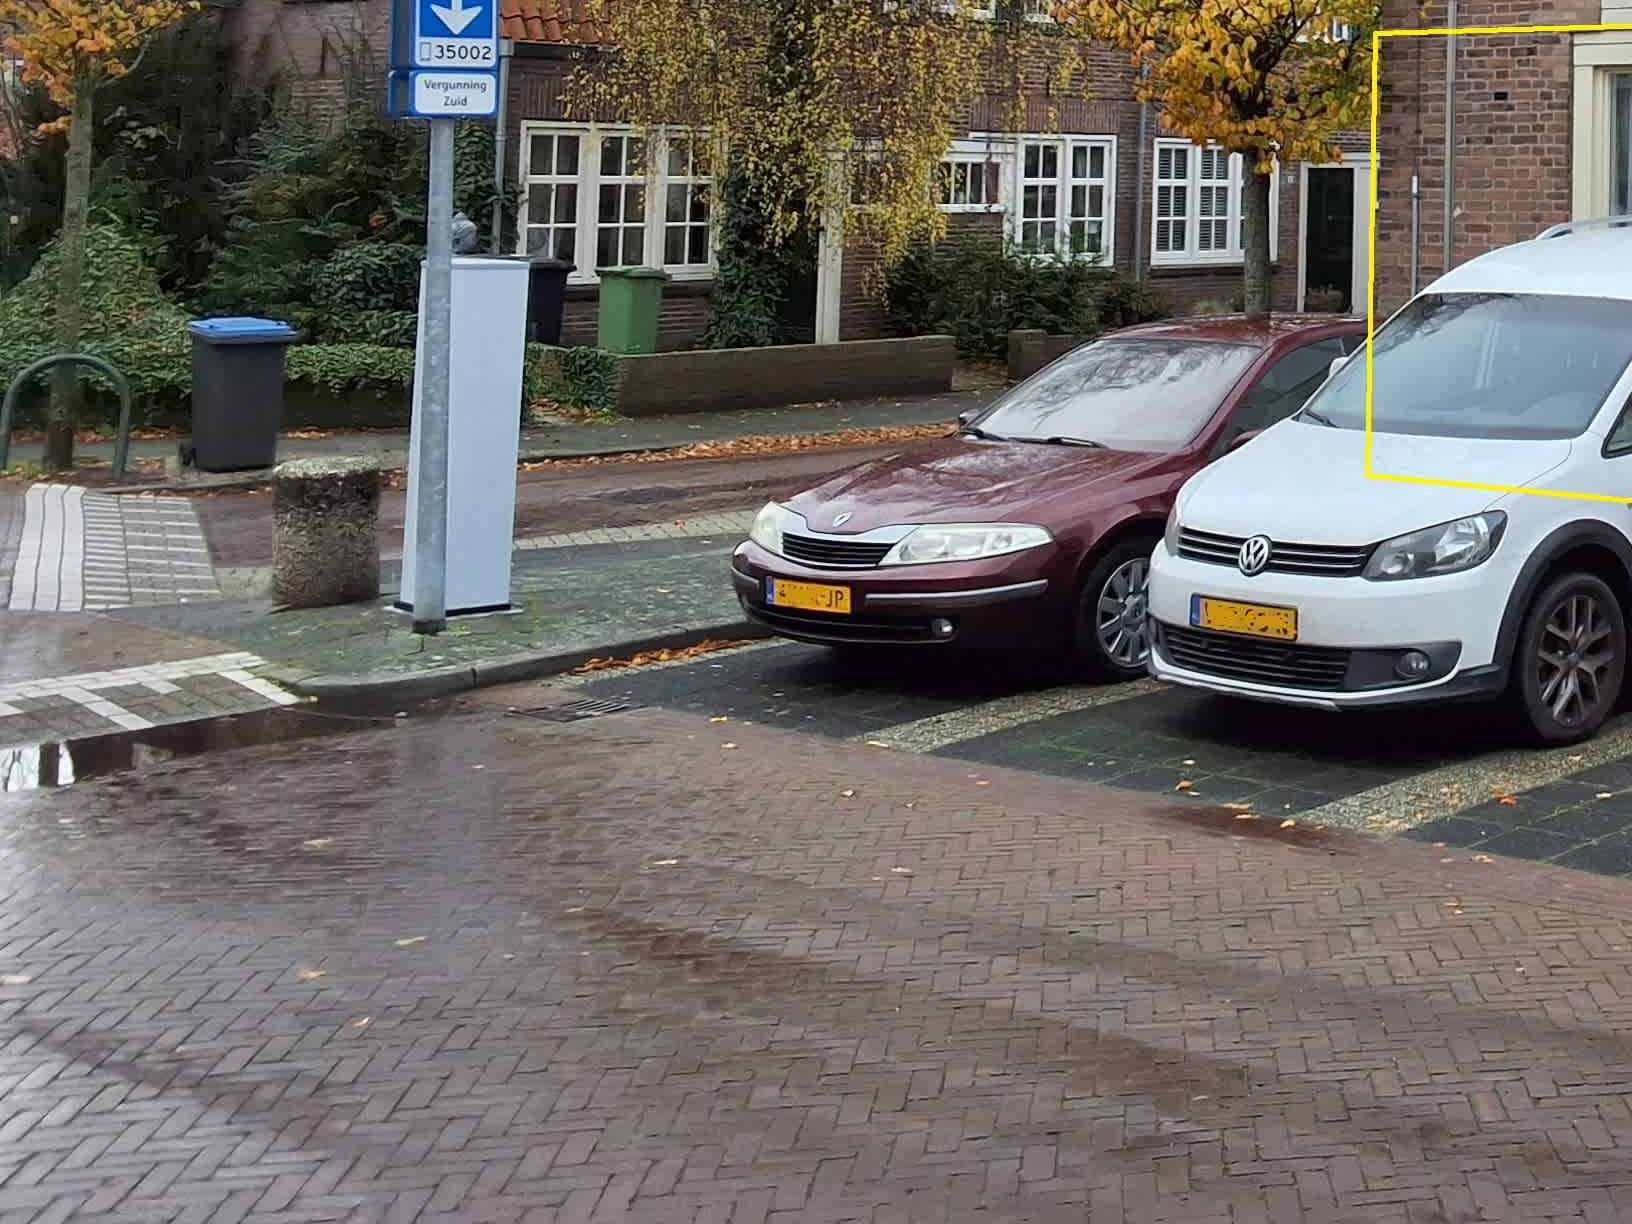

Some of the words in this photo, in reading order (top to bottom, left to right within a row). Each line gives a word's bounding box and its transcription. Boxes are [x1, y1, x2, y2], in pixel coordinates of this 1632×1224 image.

[434, 44, 492, 60] 35002
[423, 79, 487, 93] Vergunning
[443, 95, 468, 106] Zuid
